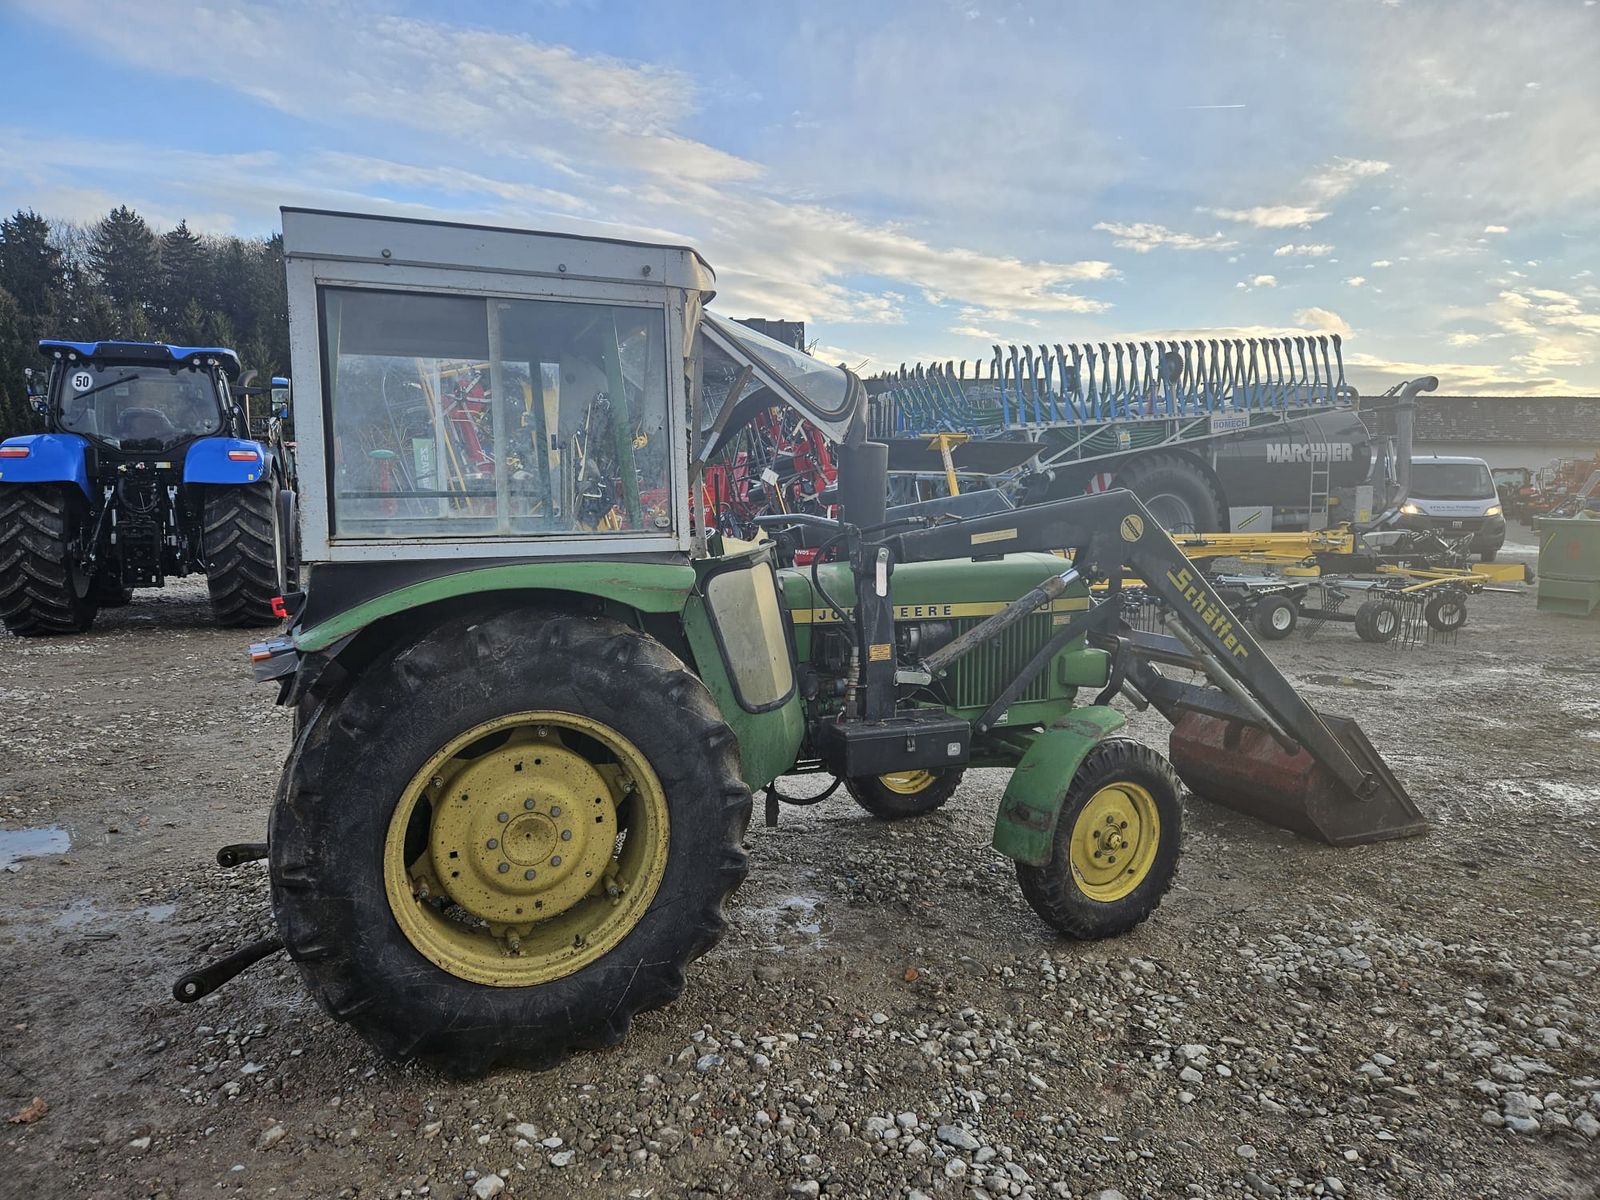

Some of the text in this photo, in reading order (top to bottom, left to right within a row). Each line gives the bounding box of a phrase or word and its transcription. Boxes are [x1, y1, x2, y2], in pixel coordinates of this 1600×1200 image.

[75, 375, 90, 388] 50
[1266, 443, 1353, 463] MARCHNER
[818, 605, 952, 621] JOH EERE
[1166, 567, 1249, 658] Schäffer
